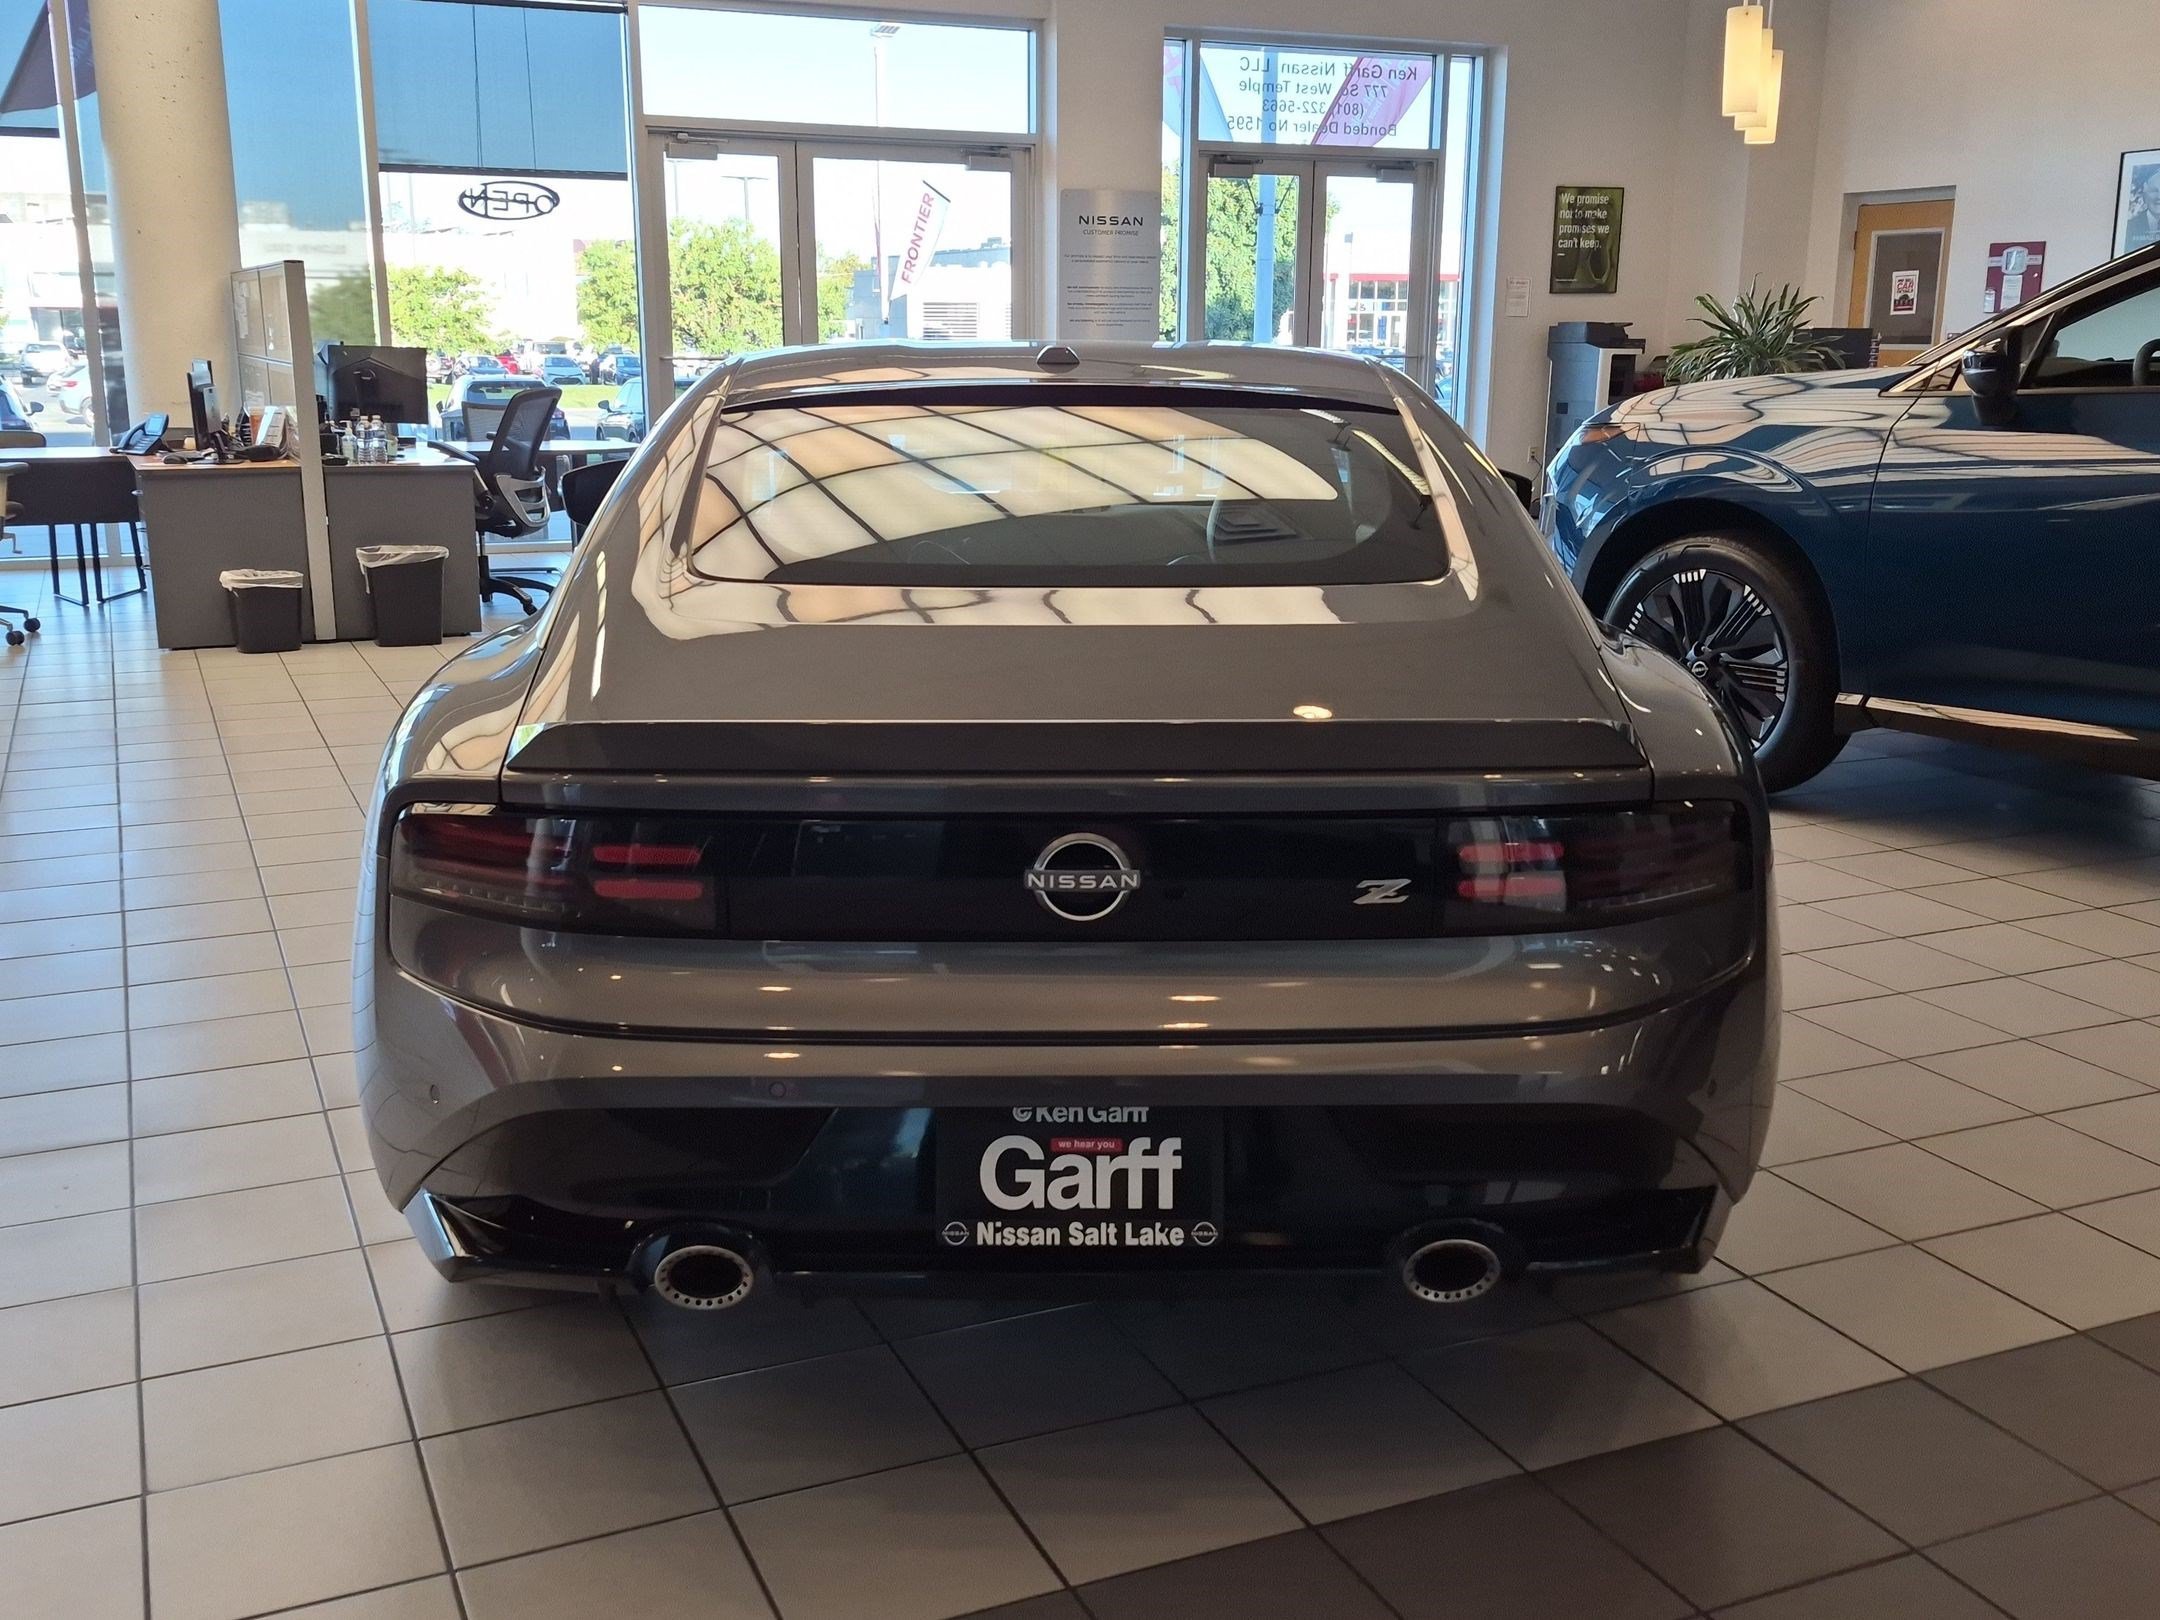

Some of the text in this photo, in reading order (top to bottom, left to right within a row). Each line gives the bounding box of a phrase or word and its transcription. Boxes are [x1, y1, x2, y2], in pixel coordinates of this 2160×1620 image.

[1561, 193, 1610, 206] We promise
[1078, 215, 1144, 226] NISSAN
[1584, 208, 1608, 219] make
[1559, 224, 1610, 236] promises we
[901, 192, 935, 284] FRONTIER
[1558, 237, 1602, 251] can't keep.
[1027, 872, 1139, 890] NISSAN
[1353, 878, 1412, 905] Z
[1035, 1106, 1084, 1123] Ken
[1058, 1139, 1116, 1151] we hear you
[979, 1134, 1183, 1211] Garff
[976, 1221, 1185, 1246] Nissan Salt Lake
